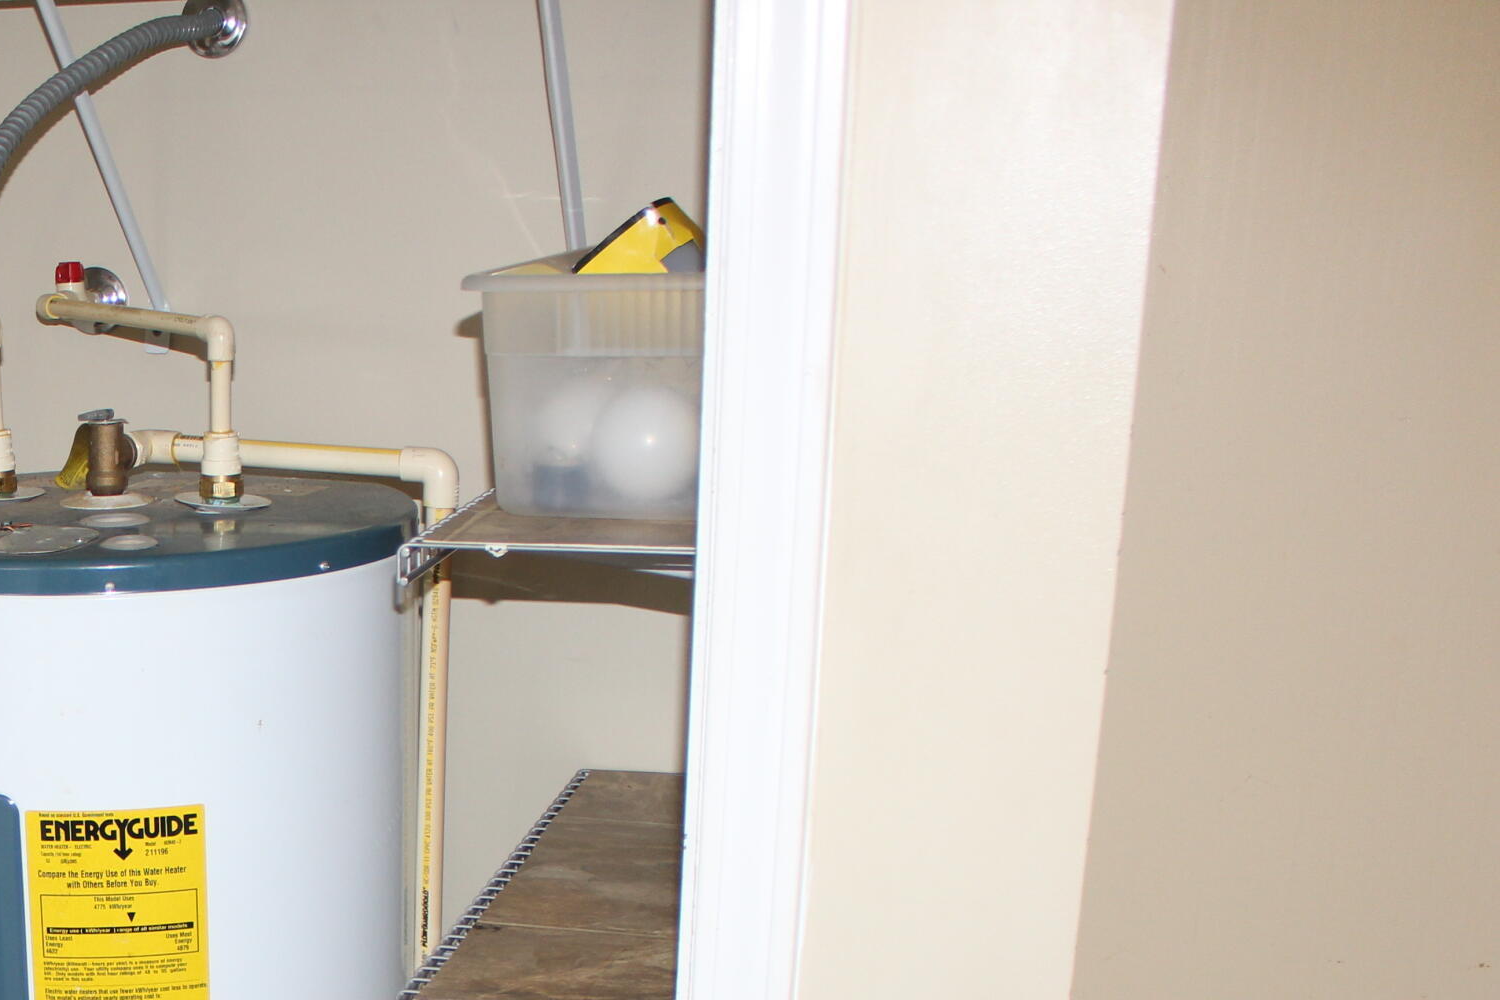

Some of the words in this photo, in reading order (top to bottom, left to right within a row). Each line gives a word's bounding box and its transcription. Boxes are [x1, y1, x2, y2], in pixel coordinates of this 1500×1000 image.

[40, 814, 198, 842] ENERGYGUIDE
[38, 870, 66, 879] Compare
[81, 870, 104, 879] Energy
[105, 870, 118, 878] Use
[120, 869, 127, 877] of
[143, 868, 163, 876] Water
[164, 866, 187, 874] Heater
[67, 881, 80, 889] with
[83, 881, 104, 889] Others
[106, 880, 127, 888] Before
